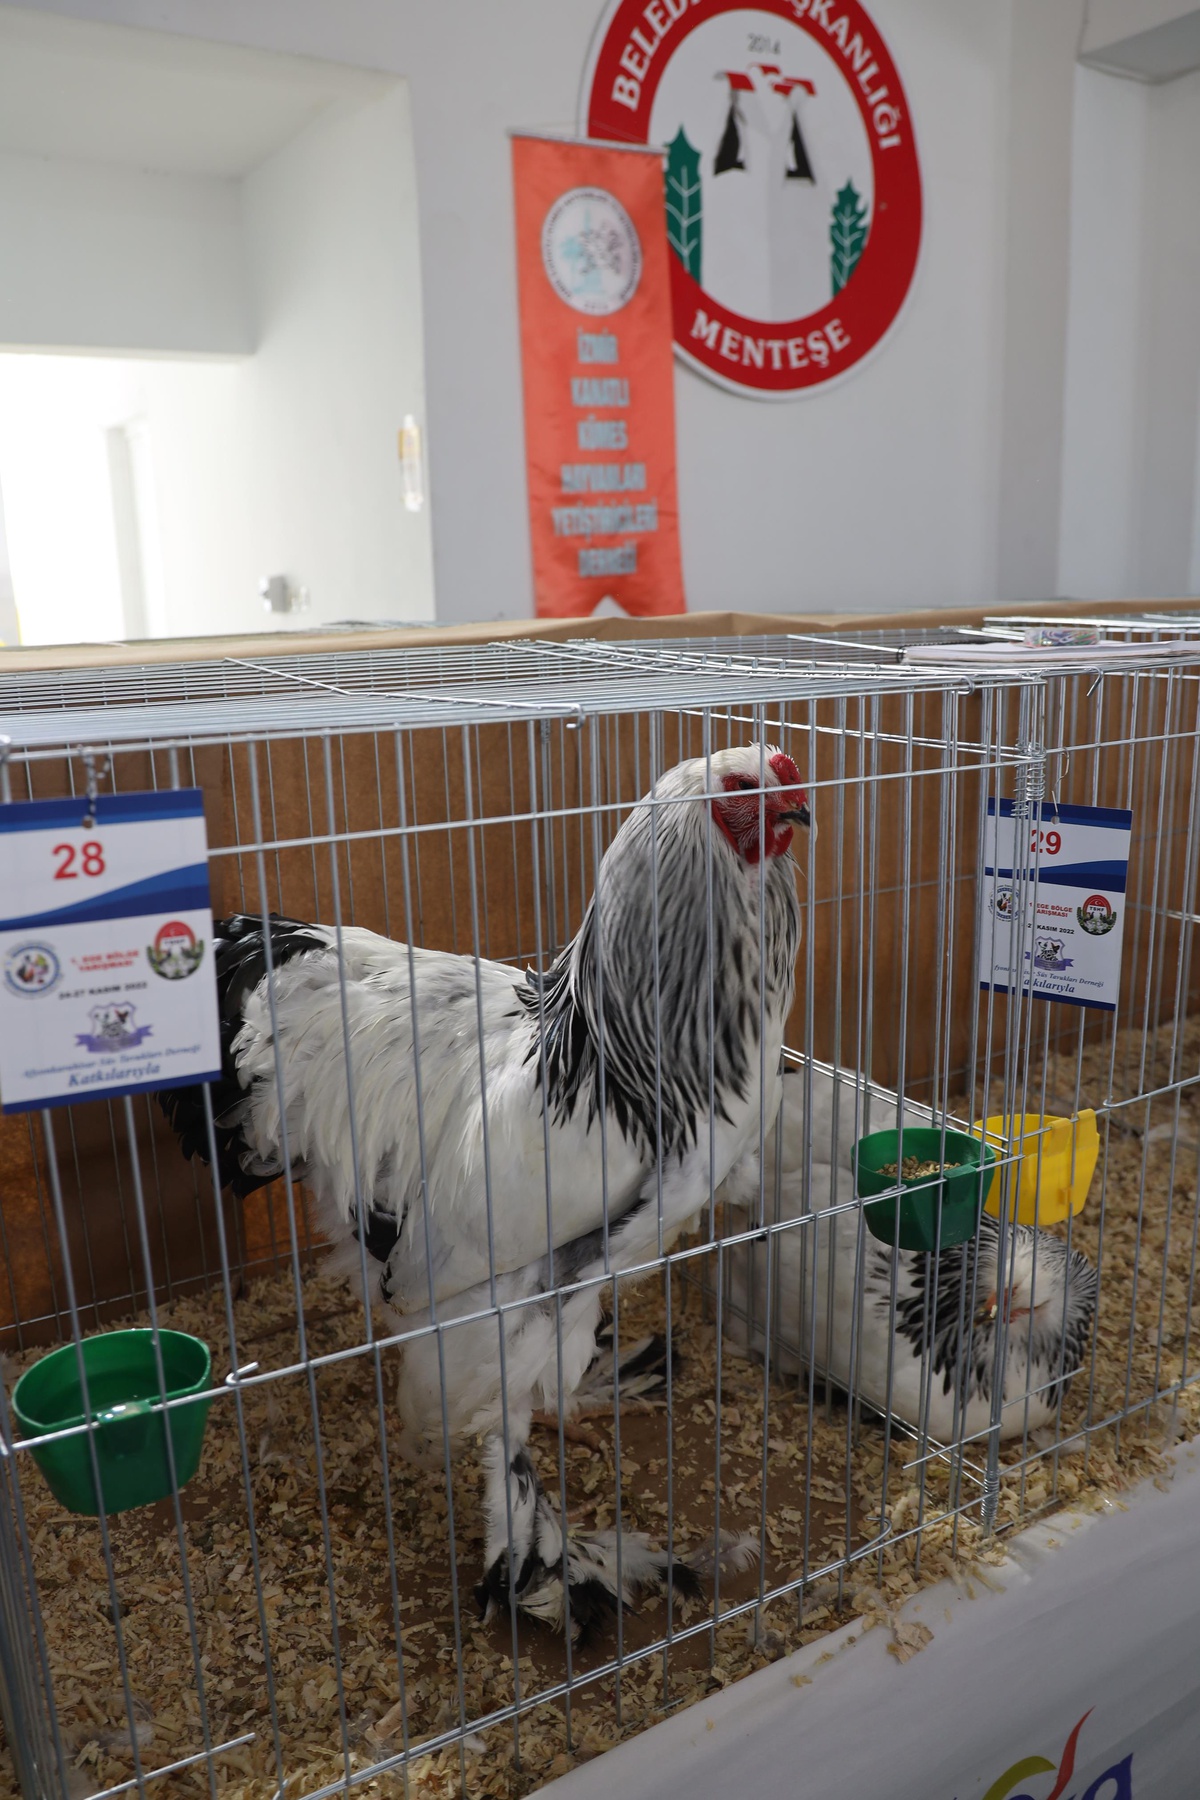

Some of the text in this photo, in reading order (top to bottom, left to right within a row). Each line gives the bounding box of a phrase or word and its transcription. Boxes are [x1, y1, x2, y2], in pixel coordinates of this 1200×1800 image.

[611, 0, 901, 150] BELED ŞKANLIĞI
[690, 309, 851, 367] MENTEŞE
[1030, 829, 1062, 855] 29
[52, 841, 106, 881] 28
[1036, 909, 1068, 917] ARIŞMASI
[1051, 904, 1073, 912] BÖLGE
[1059, 927, 1075, 935] 2022
[1022, 977, 1075, 993] akılarıyla
[68, 1063, 161, 1087] Katkılarıyla
